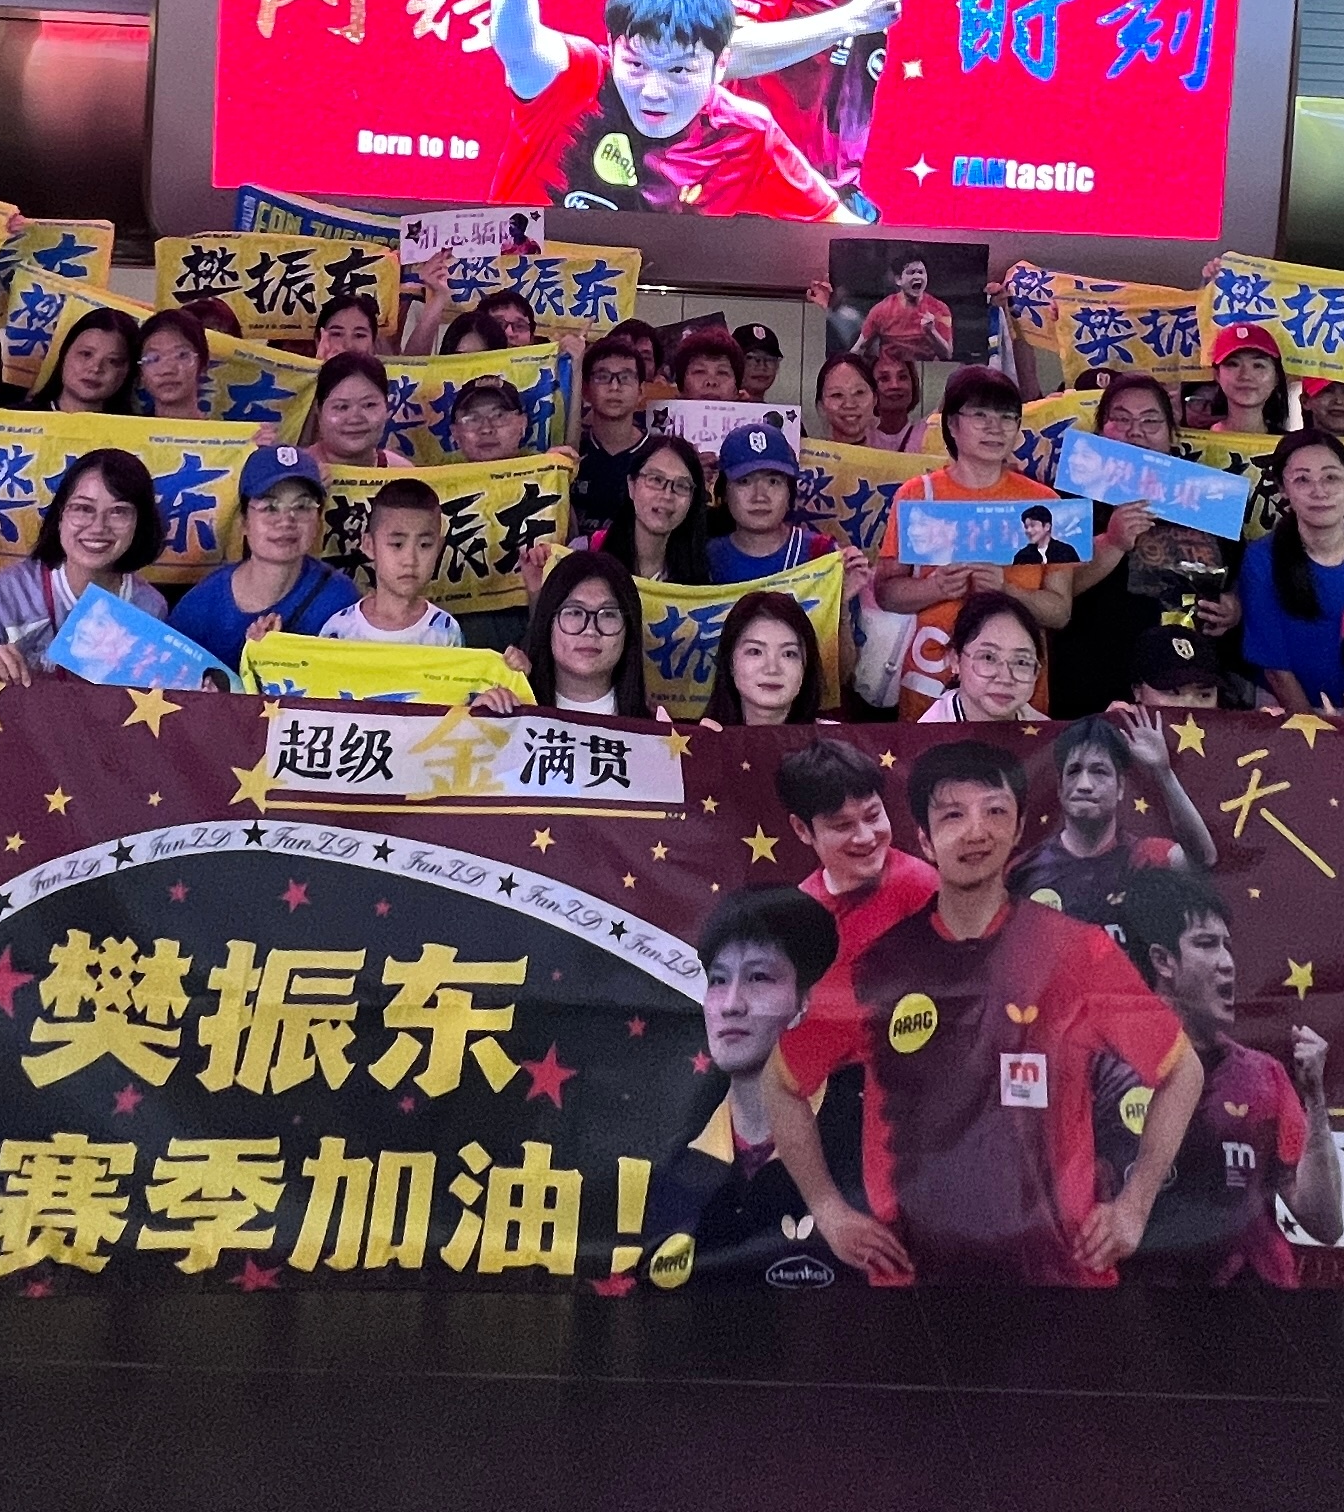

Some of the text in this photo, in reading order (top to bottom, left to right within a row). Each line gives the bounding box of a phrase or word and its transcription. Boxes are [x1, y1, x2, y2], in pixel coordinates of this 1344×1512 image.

[356, 128, 481, 160] Born to be
[953, 156, 1095, 193] FANtastic
[170, 244, 387, 317] 樊振东
[1071, 305, 1201, 367] 樊振
[273, 707, 633, 802] 超级金满贯
[21, 928, 528, 1098] 樊振东
[893, 1010, 934, 1035] ARAG
[772, 1264, 830, 1285] Henkel
